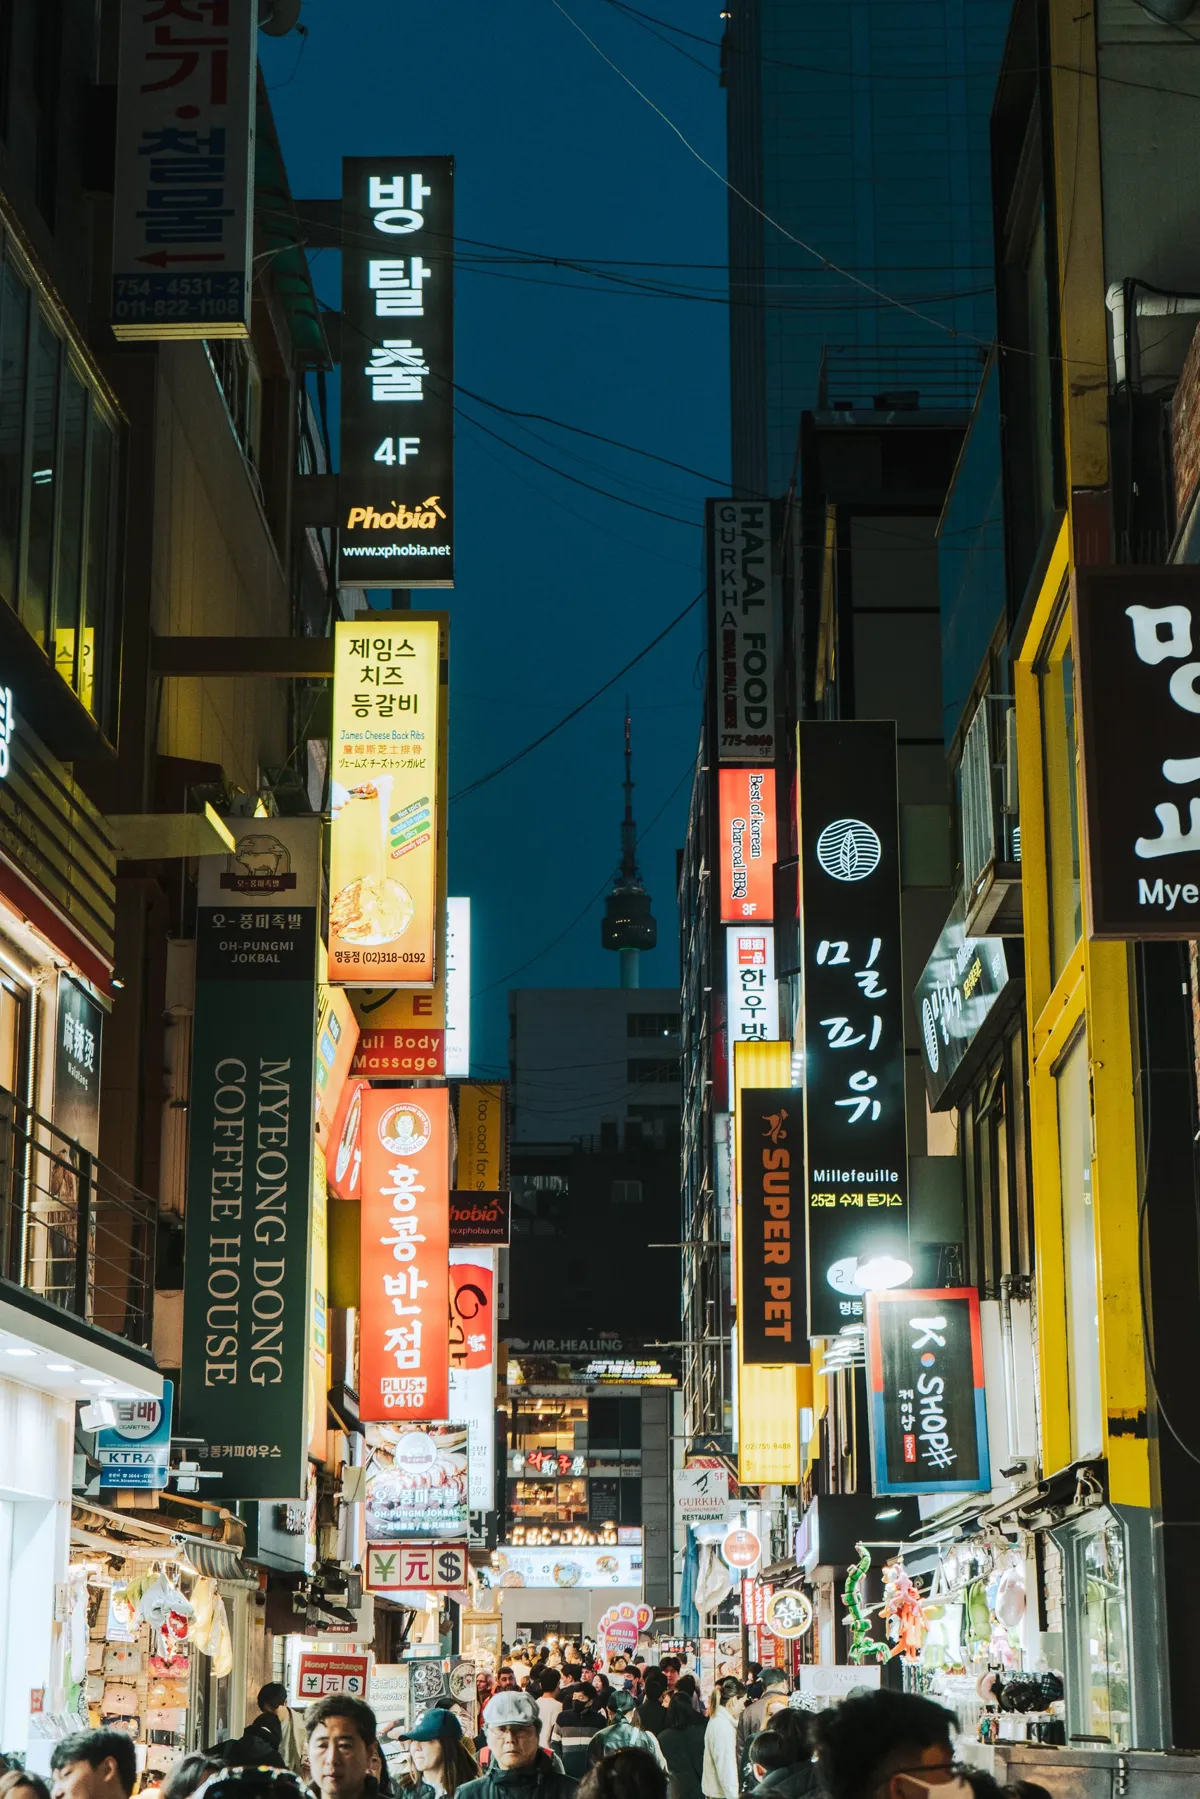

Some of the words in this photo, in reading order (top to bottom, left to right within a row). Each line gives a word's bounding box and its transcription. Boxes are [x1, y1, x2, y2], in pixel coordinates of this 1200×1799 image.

[364, 173, 431, 402] 방탈출
[115, 299, 239, 317] 011-822-1108
[374, 438, 420, 466] 4F
[347, 500, 440, 531] Phobia
[343, 543, 451, 559] www.xphobia.net
[740, 507, 766, 615] HALAL
[720, 506, 738, 628] GURKHA
[349, 638, 416, 662] 제임스
[360, 666, 404, 686] 치즈
[742, 633, 768, 729] FOOD
[351, 694, 418, 718] 등갈비
[340, 730, 363, 740] James
[365, 730, 390, 740] Cheese
[391, 730, 409, 740] Back
[410, 730, 425, 740] Ribs
[749, 773, 764, 800] Best
[749, 801, 764, 816] of
[731, 818, 746, 868] Charcoal
[749, 817, 764, 859] korean
[731, 871, 747, 899] BBQ
[741, 903, 756, 916] 3F
[219, 941, 294, 951] OH-PUNGMI
[231, 954, 281, 963] JOKBAL
[334, 951, 360, 963] 명동점
[362, 951, 425, 964] (02)318-0192
[359, 1036, 385, 1049] ull
[394, 1036, 440, 1051] Body
[353, 1055, 437, 1071] Massage
[478, 1100, 489, 1122] too
[210, 1057, 247, 1222] COFFEE
[477, 1125, 489, 1154] cool
[253, 1057, 291, 1245] MYEONG
[476, 1159, 489, 1176] for
[813, 1169, 898, 1182] Millefeuille
[762, 1148, 790, 1265] SUPER
[839, 1193, 863, 1207] 수제
[867, 1193, 903, 1207] 돈가스
[450, 1203, 497, 1222] hobia
[380, 1163, 428, 1369] 홍콩반점
[205, 1234, 242, 1387] HOUSE
[764, 1277, 792, 1342] PET
[249, 1258, 285, 1387] DONG
[382, 1379, 426, 1392] PLUS+
[117, 1400, 156, 1423] 담배
[384, 1394, 424, 1408] 0410
[109, 1453, 155, 1463] KTRA
[714, 1472, 725, 1480] 5F
[679, 1497, 725, 1506] GURKHA
[374, 1509, 424, 1518] OH-PUNGMI
[425, 1509, 459, 1518] JOKBAL
[404, 1553, 429, 1581] 元
[304, 1660, 328, 1670] Money
[329, 1661, 364, 1672] Exchange
[325, 1678, 339, 1691] 元
